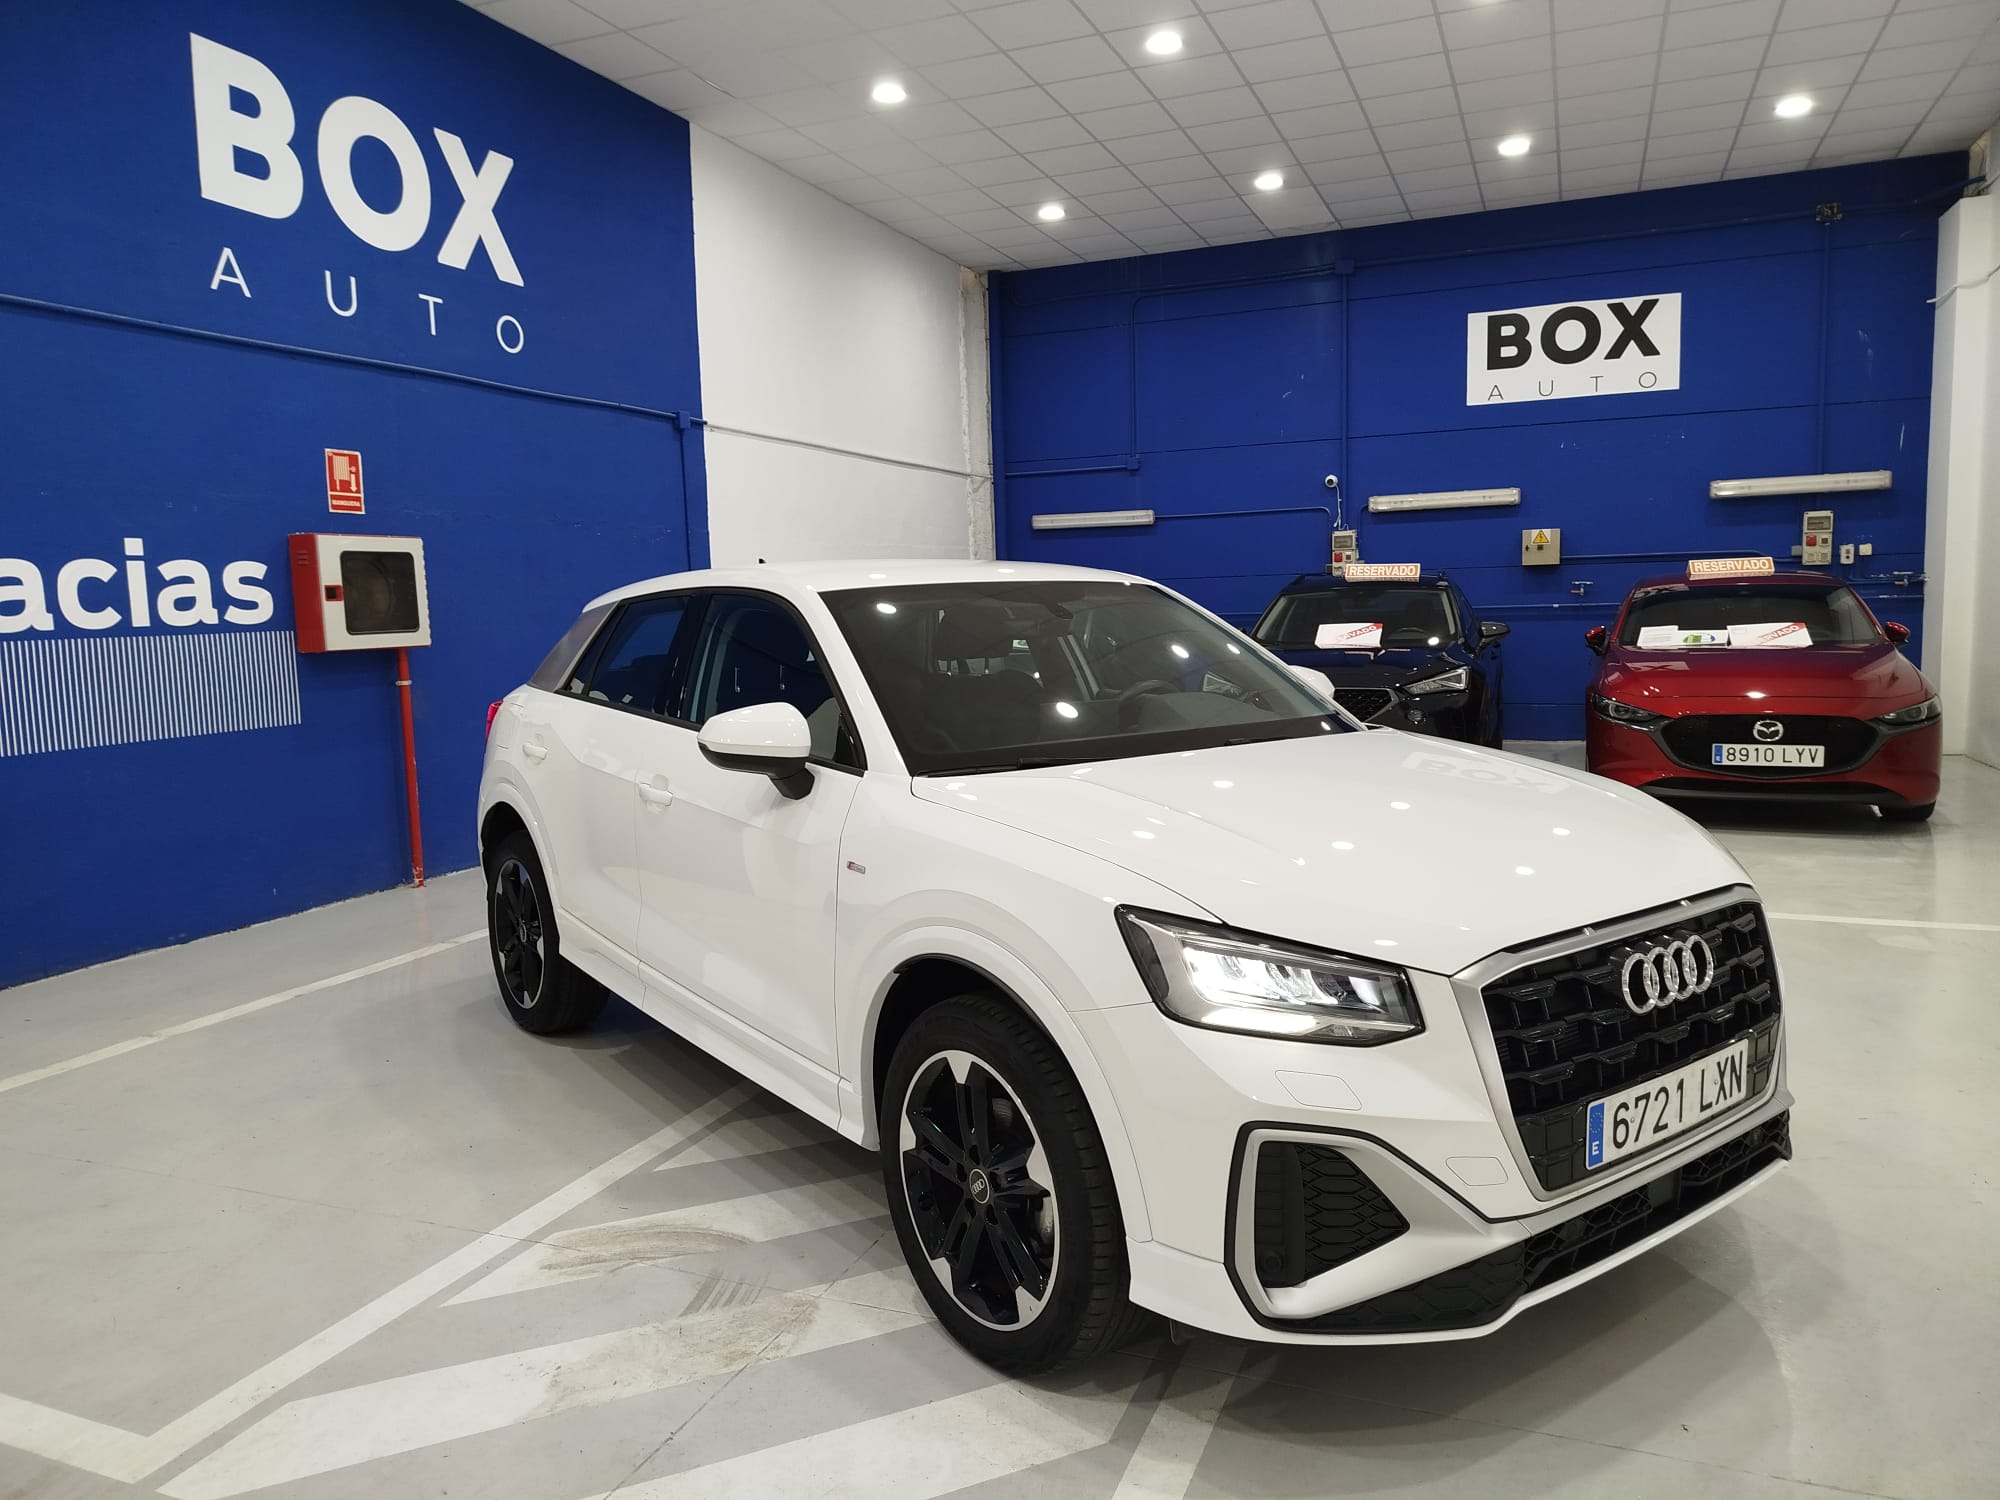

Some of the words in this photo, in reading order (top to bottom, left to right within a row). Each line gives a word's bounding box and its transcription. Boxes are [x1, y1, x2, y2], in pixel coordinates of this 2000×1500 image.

[190, 32, 524, 288] BOX
[210, 247, 525, 354] AUTO
[1487, 298, 1661, 371] BOX
[1487, 371, 1658, 401] AUTO
[0, 537, 274, 634] acias
[1349, 565, 1416, 576] RESERVADO
[1694, 559, 1769, 573] RESERVADO
[1726, 747, 1775, 763] 8910
[1782, 748, 1819, 764] LYV
[1591, 1140, 1600, 1156] E
[1612, 1078, 1685, 1150] 6721
[1700, 1050, 1743, 1113] LXN
